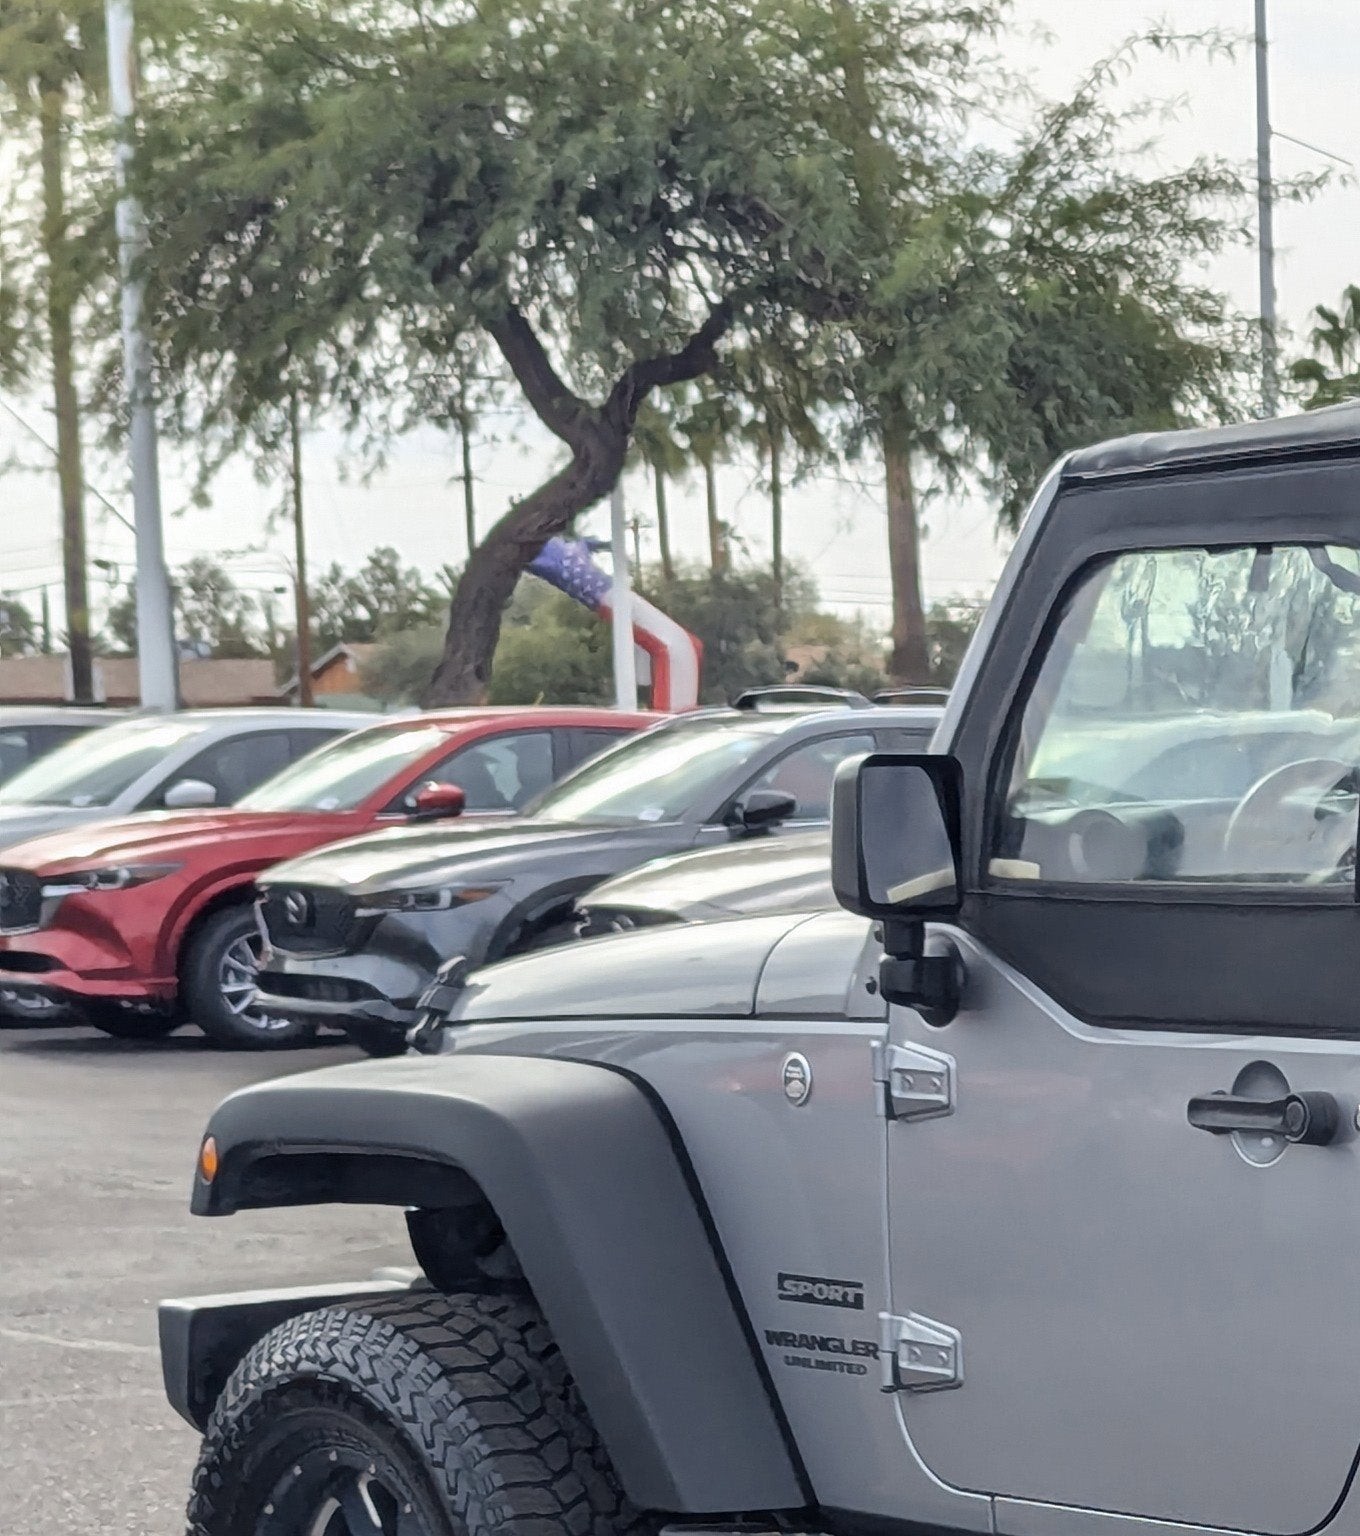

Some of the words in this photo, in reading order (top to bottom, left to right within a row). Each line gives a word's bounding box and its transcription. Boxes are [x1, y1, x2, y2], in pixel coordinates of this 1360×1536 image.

[783, 1279, 864, 1303] SPORT
[764, 1329, 880, 1360] WRANGLER
[784, 1355, 868, 1376] UNLIMITED
